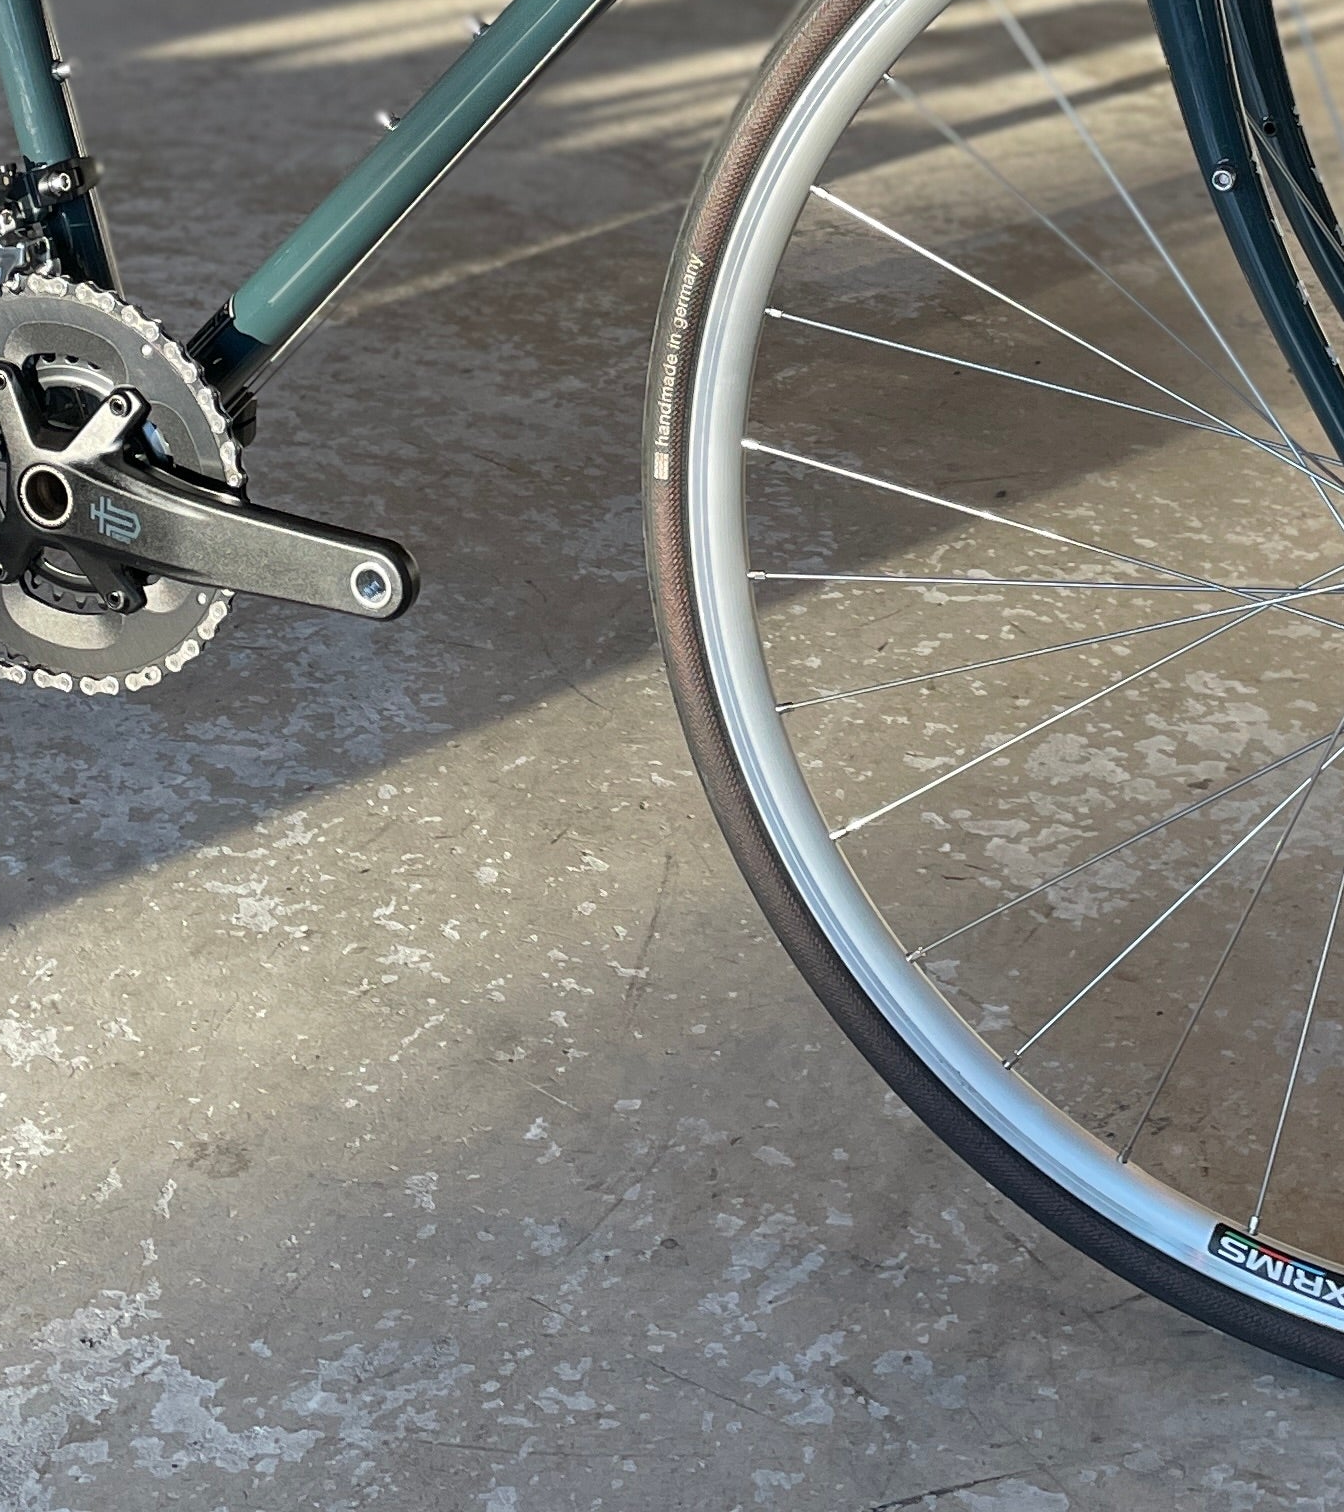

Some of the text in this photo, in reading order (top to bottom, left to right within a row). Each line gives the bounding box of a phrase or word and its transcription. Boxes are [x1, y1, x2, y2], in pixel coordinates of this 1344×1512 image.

[654, 254, 705, 447] handmade in germany
